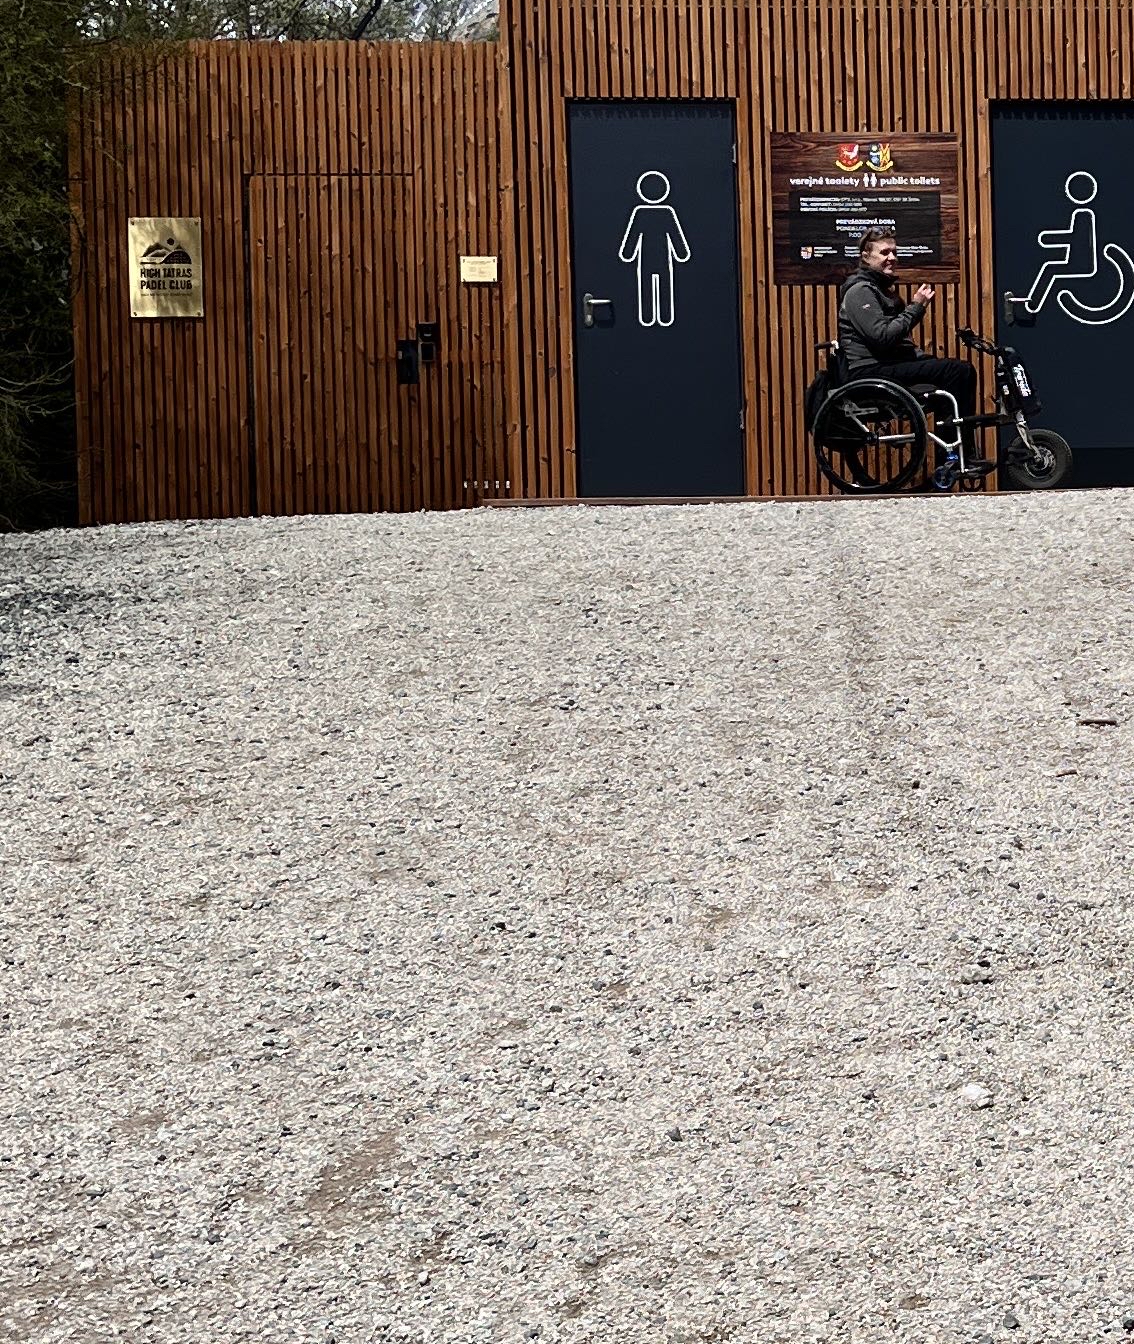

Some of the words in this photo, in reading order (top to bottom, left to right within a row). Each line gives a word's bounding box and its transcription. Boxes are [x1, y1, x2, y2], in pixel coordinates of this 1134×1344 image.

[790, 176, 824, 187] verejné
[825, 176, 860, 187] toalety
[880, 176, 909, 187] public
[909, 176, 940, 185] toilets
[140, 268, 160, 278] HIGH
[163, 268, 192, 278] TATRAS
[140, 280, 167, 290] PADEL
[169, 280, 192, 290] CLUB
